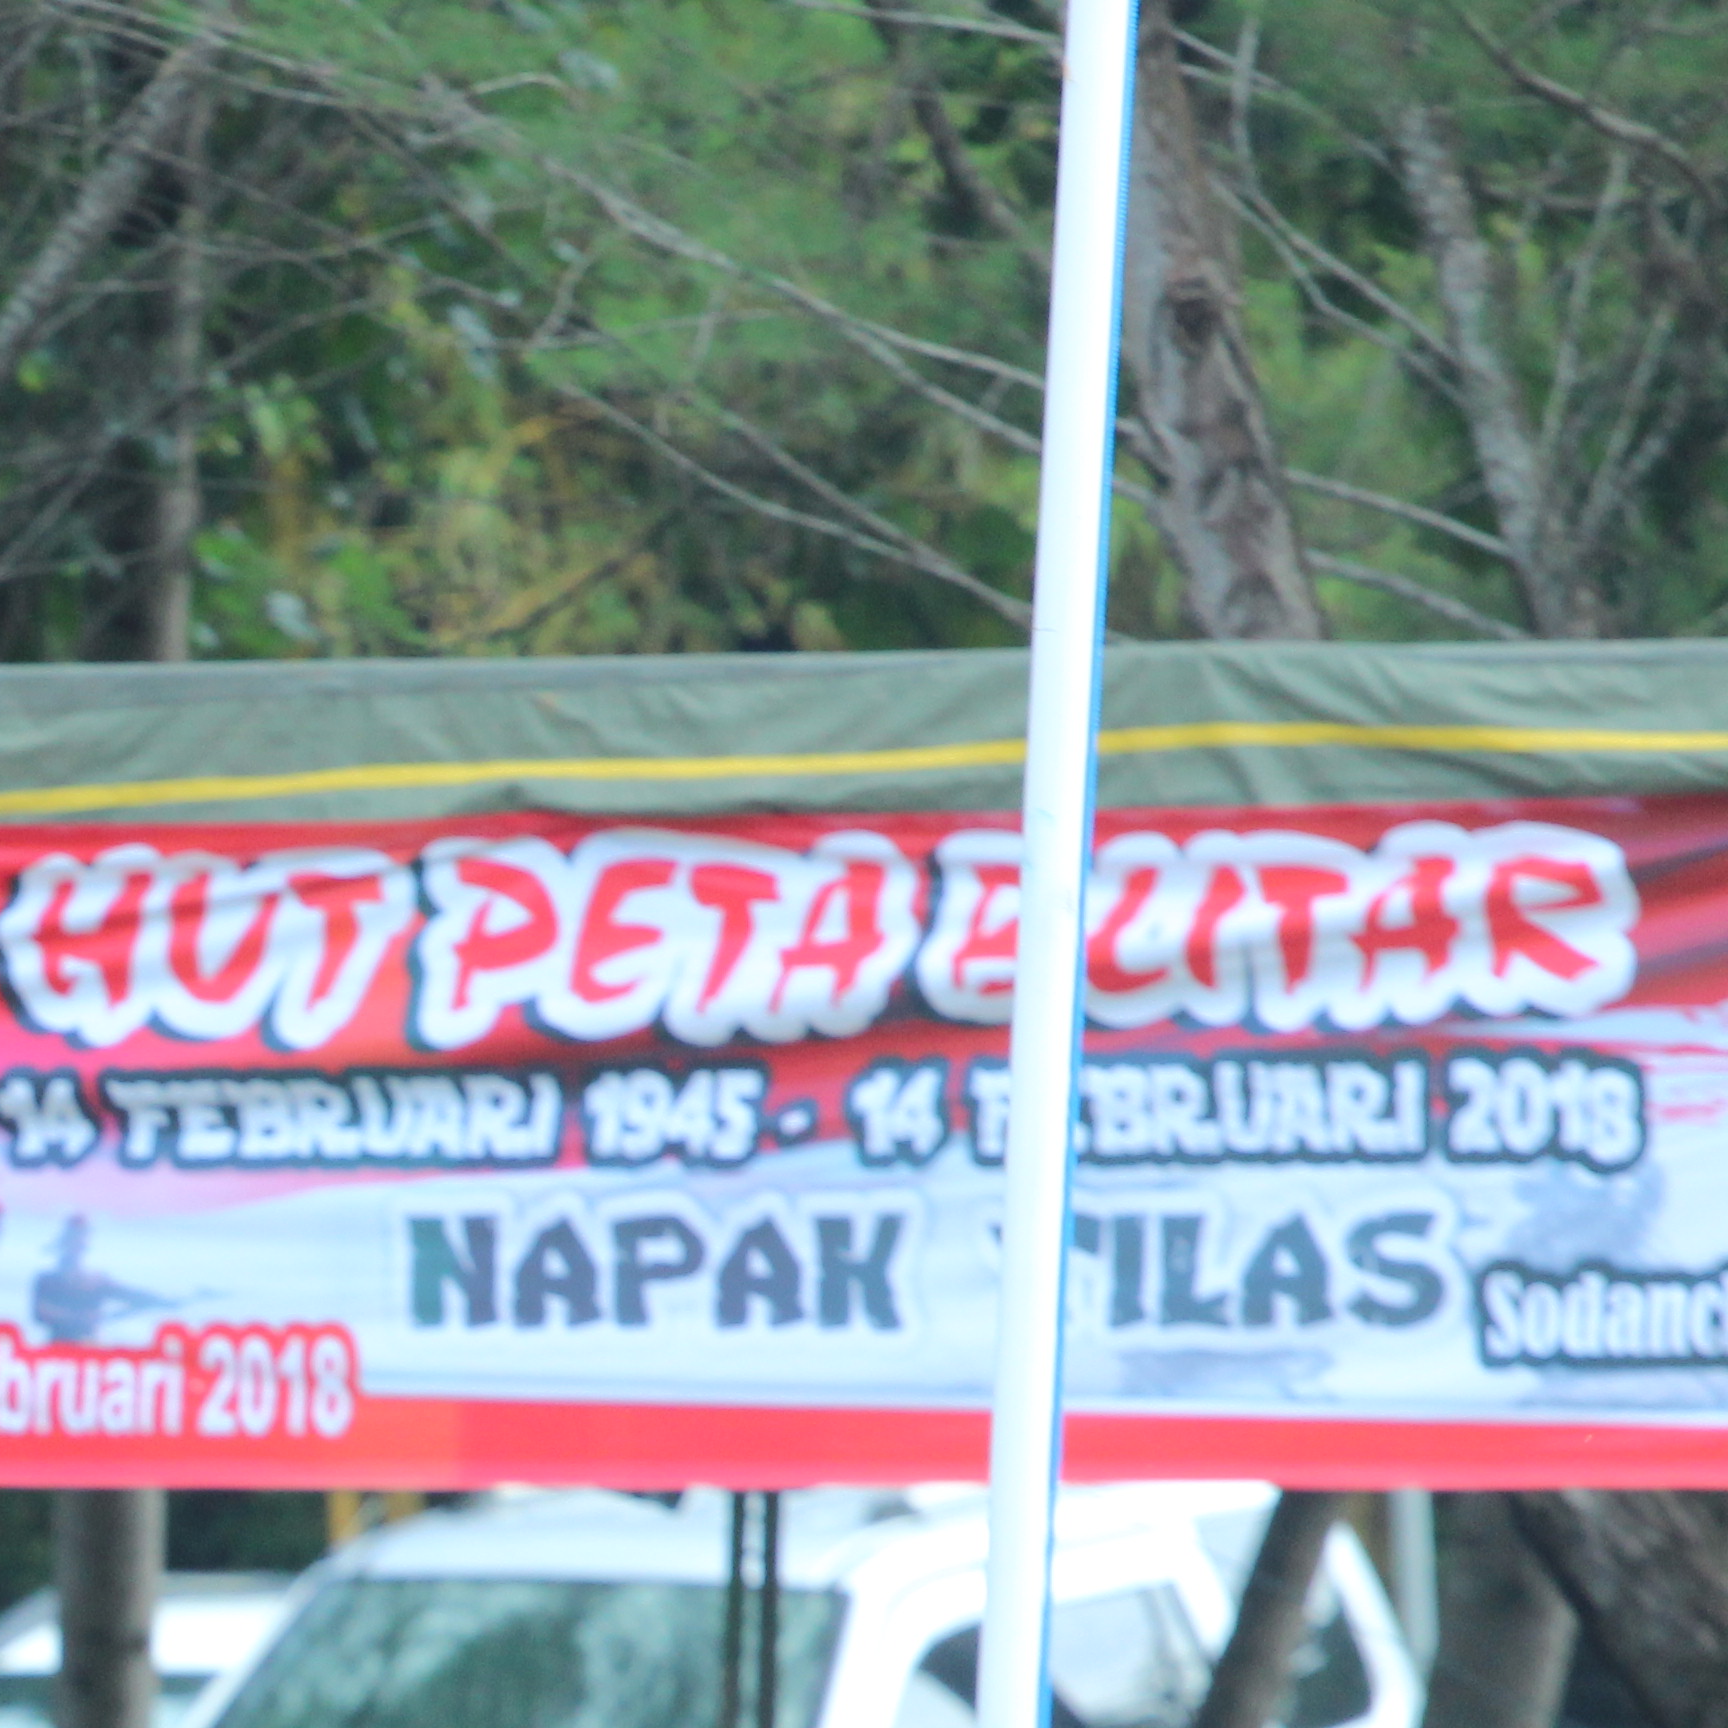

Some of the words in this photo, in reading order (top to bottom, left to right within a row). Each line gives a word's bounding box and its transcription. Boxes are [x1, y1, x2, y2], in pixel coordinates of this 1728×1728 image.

[12, 854, 402, 1034] HUT
[434, 844, 901, 1034] PETA
[104, 1074, 562, 1160] FEBRUARI
[582, 1065, 764, 1158] 1945
[849, 1065, 946, 1157] 14
[968, 1060, 1428, 1156] FBRUARI
[1446, 1056, 1641, 1166] 2018
[407, 1213, 906, 1329] NAPAK
[194, 1333, 353, 1438] 2018
